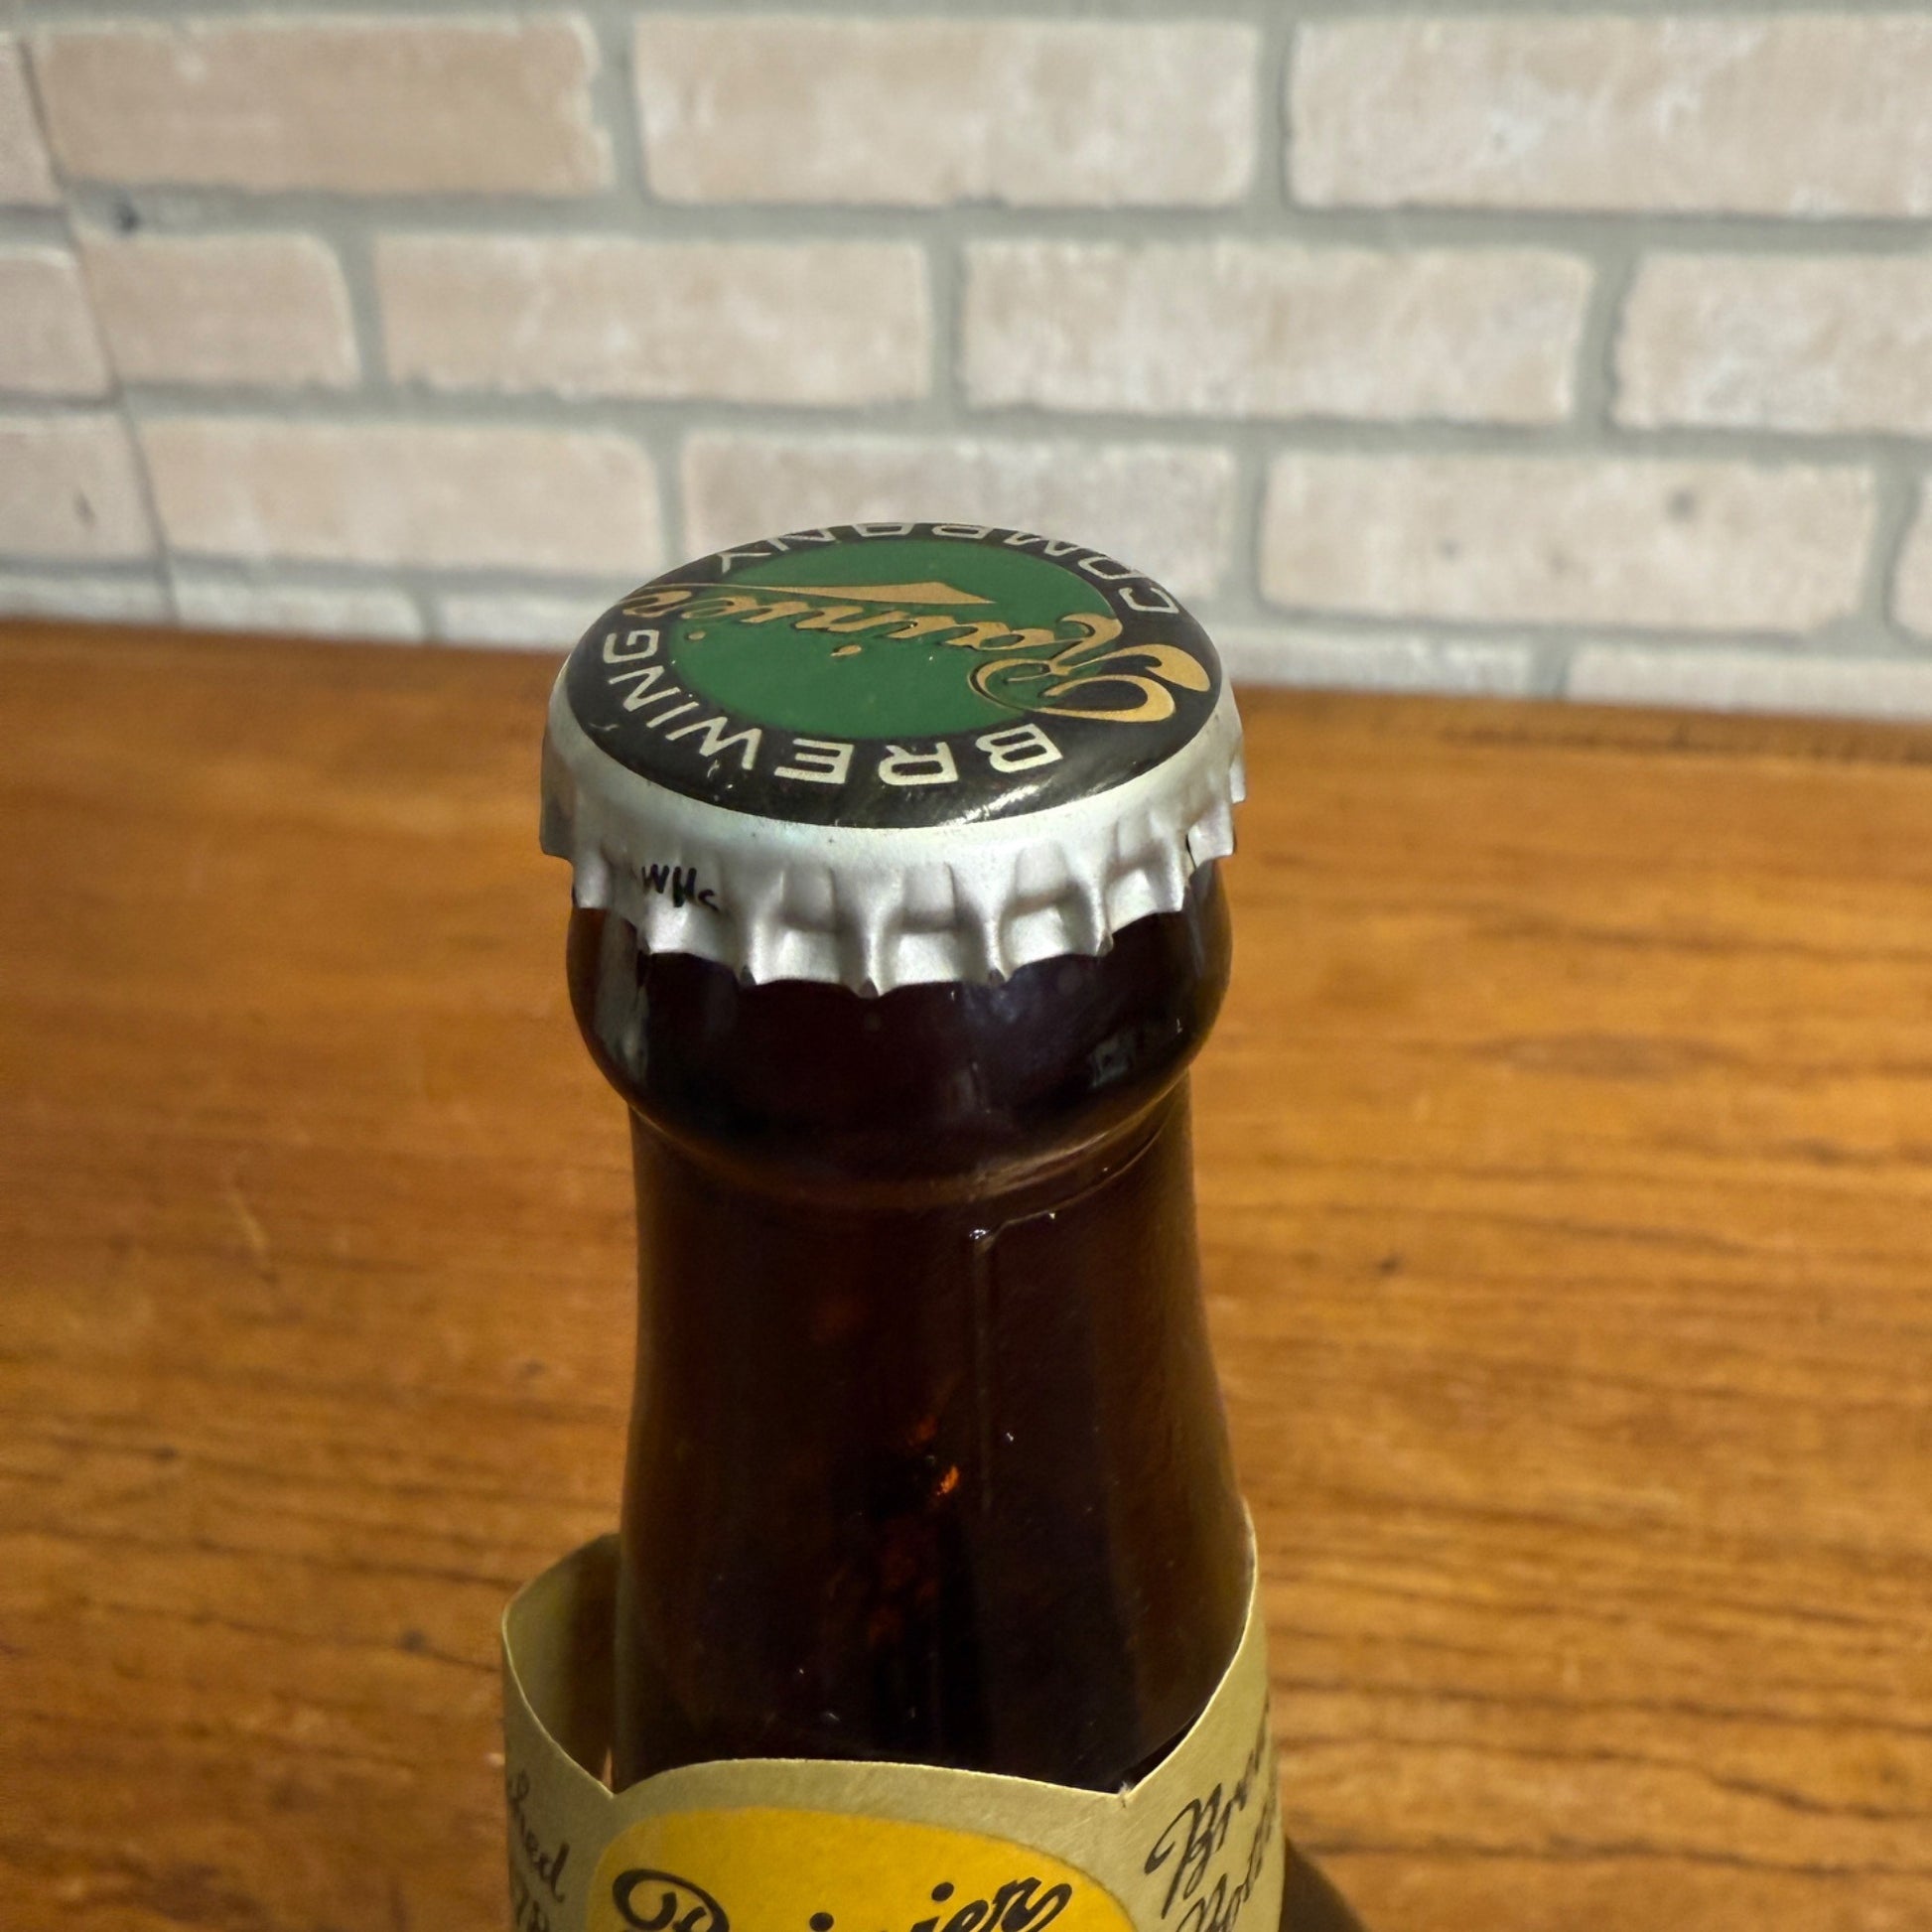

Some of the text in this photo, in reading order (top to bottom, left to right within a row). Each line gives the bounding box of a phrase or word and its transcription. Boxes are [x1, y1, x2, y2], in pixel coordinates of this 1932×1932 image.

[717, 523, 1179, 614] COMPANY
[603, 629, 1062, 785] BREWING
[616, 583, 1211, 723] Rainier
